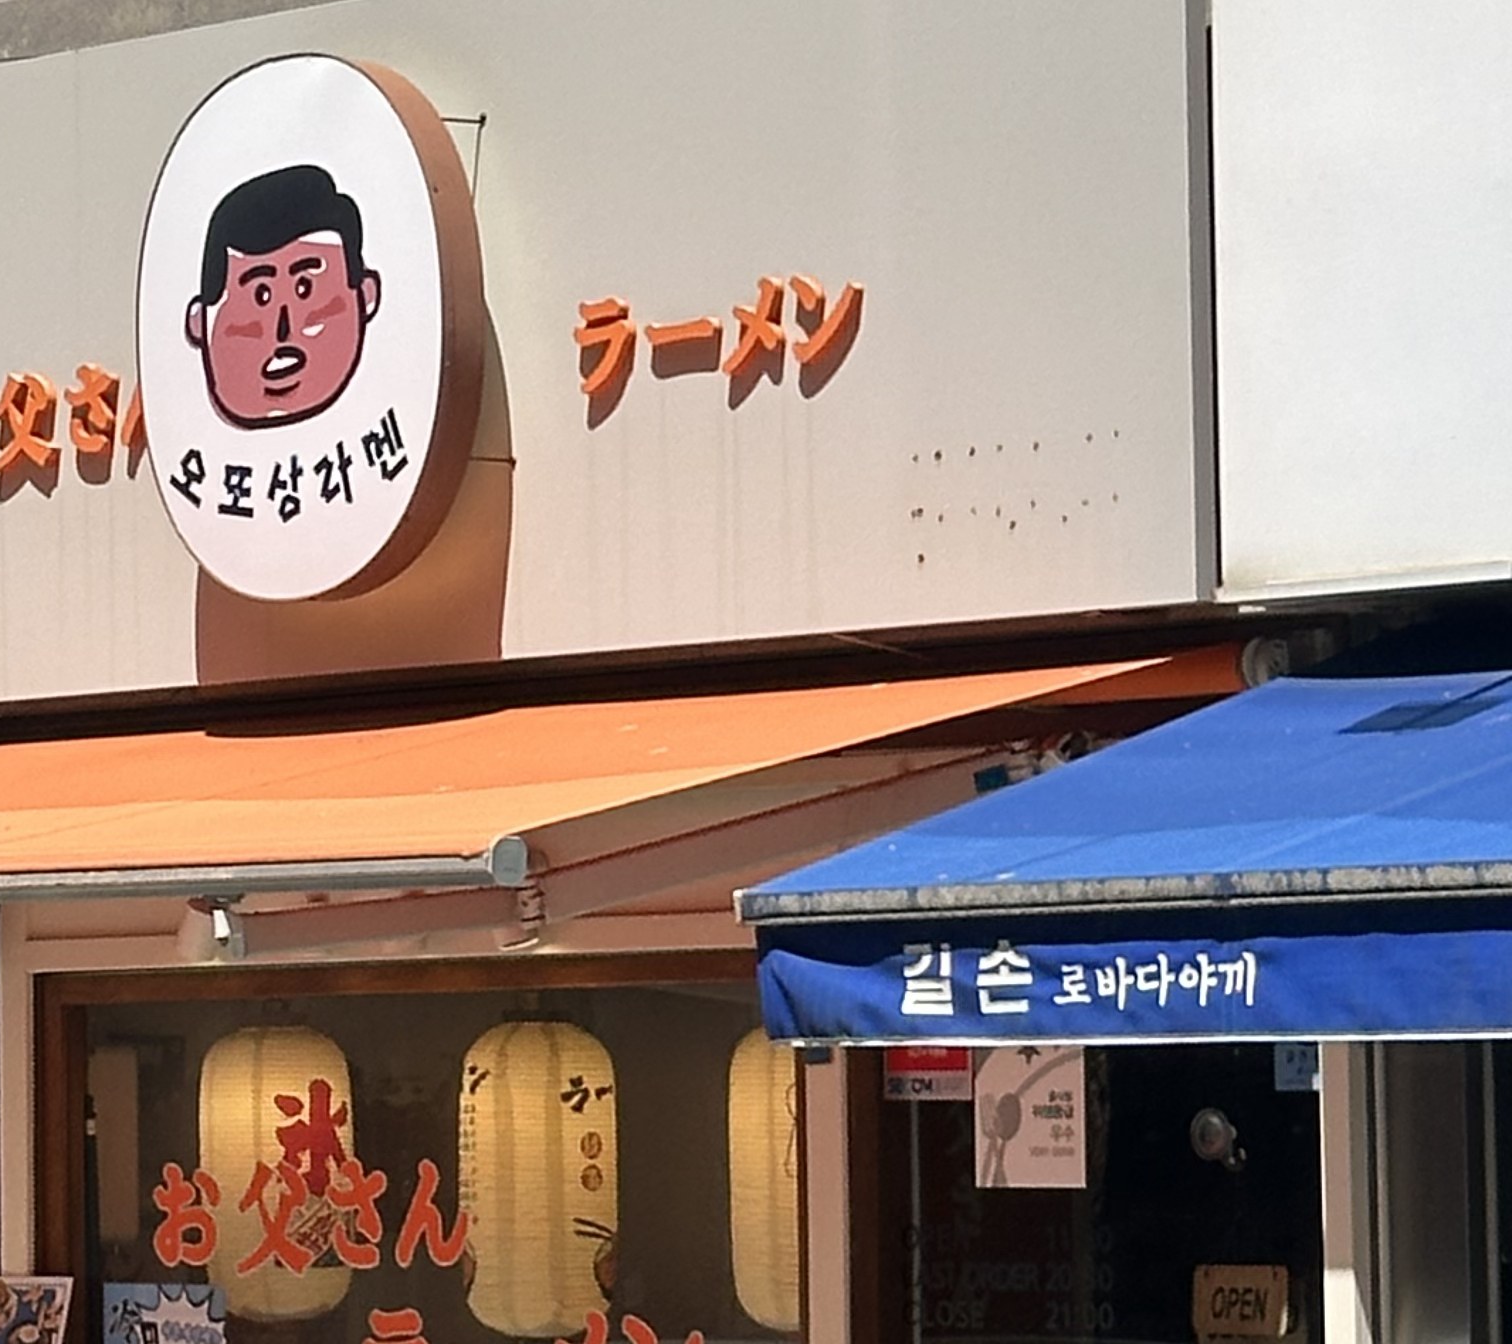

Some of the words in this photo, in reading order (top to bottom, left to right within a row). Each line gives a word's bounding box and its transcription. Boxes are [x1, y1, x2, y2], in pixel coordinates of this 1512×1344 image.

[573, 273, 866, 399] ラーメン
[168, 406, 410, 523] 오또상라멘
[1051, 951, 1258, 1011] 로바다야끼
[1049, 1125, 1076, 1144] 우수
[152, 1158, 475, 1277] お父さん
[1210, 1286, 1270, 1322] OPEN
